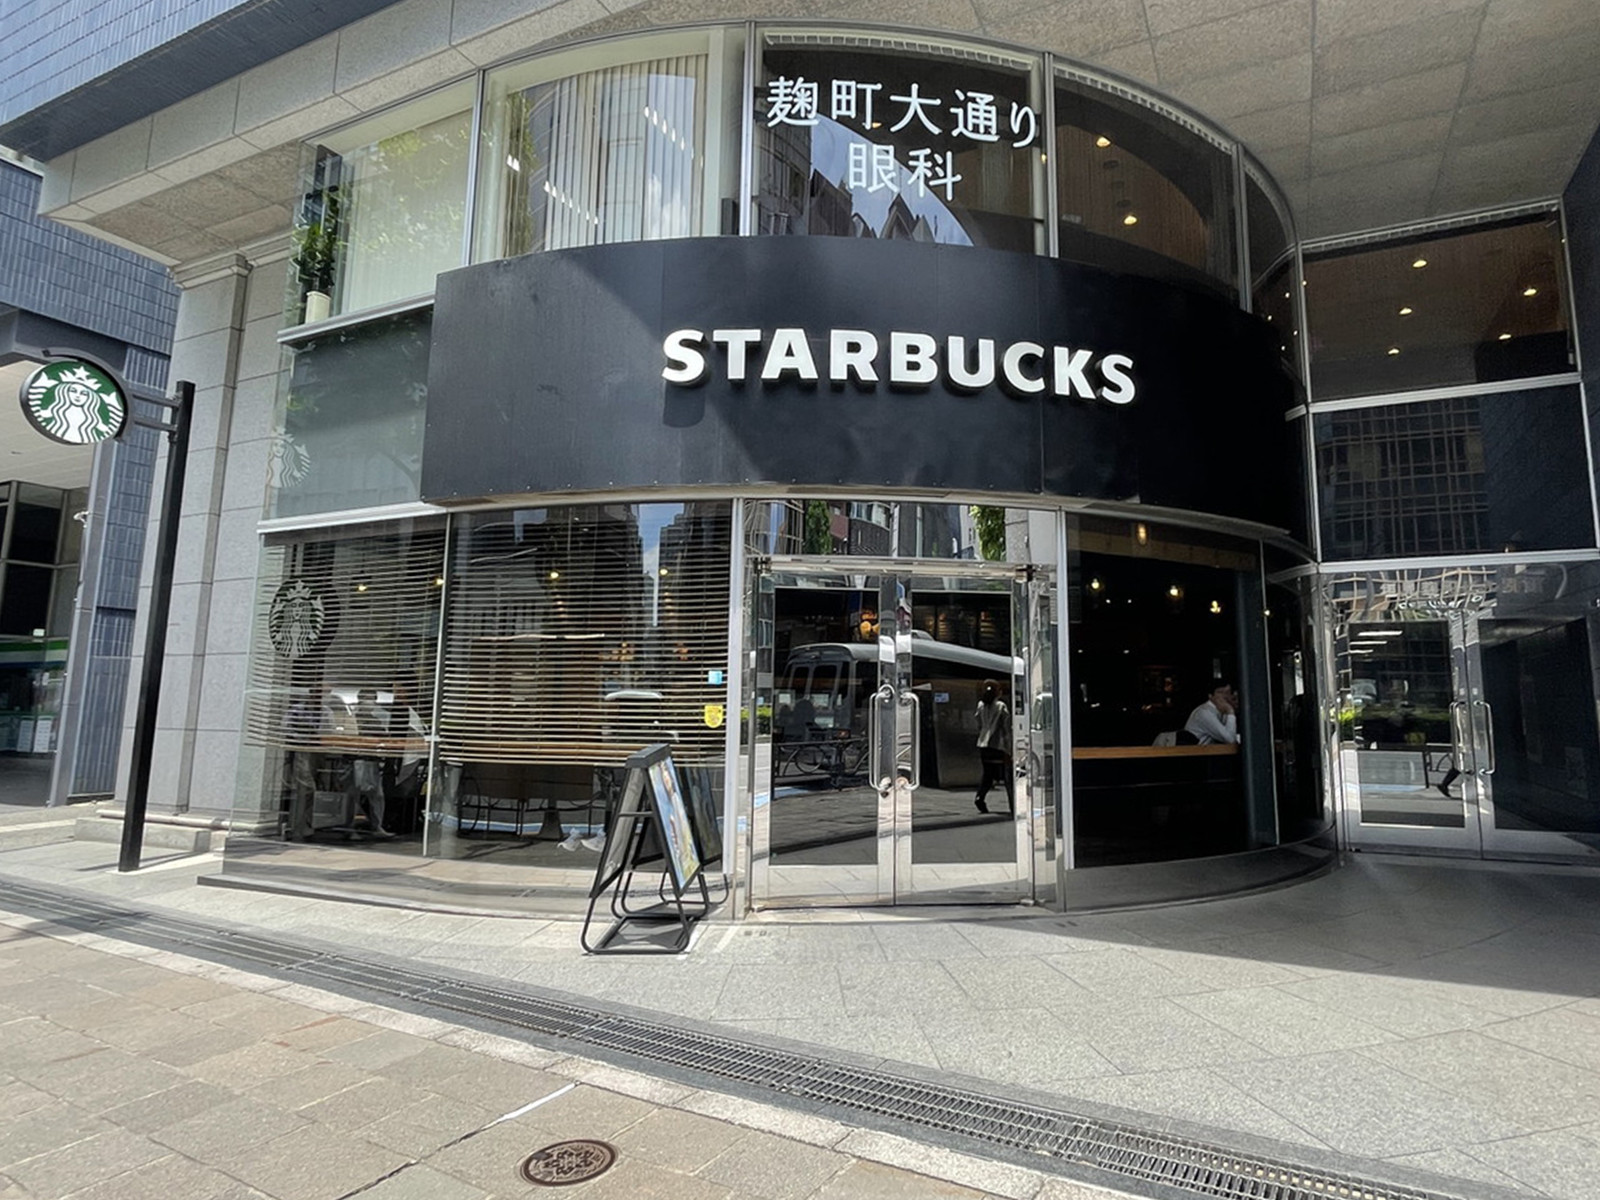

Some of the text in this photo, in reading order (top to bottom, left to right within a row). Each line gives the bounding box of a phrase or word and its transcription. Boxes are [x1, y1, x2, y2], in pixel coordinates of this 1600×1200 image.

[767, 76, 1038, 148] 麹町大通り
[849, 143, 962, 201] 眼科
[662, 328, 1136, 405] STARBUCKS
